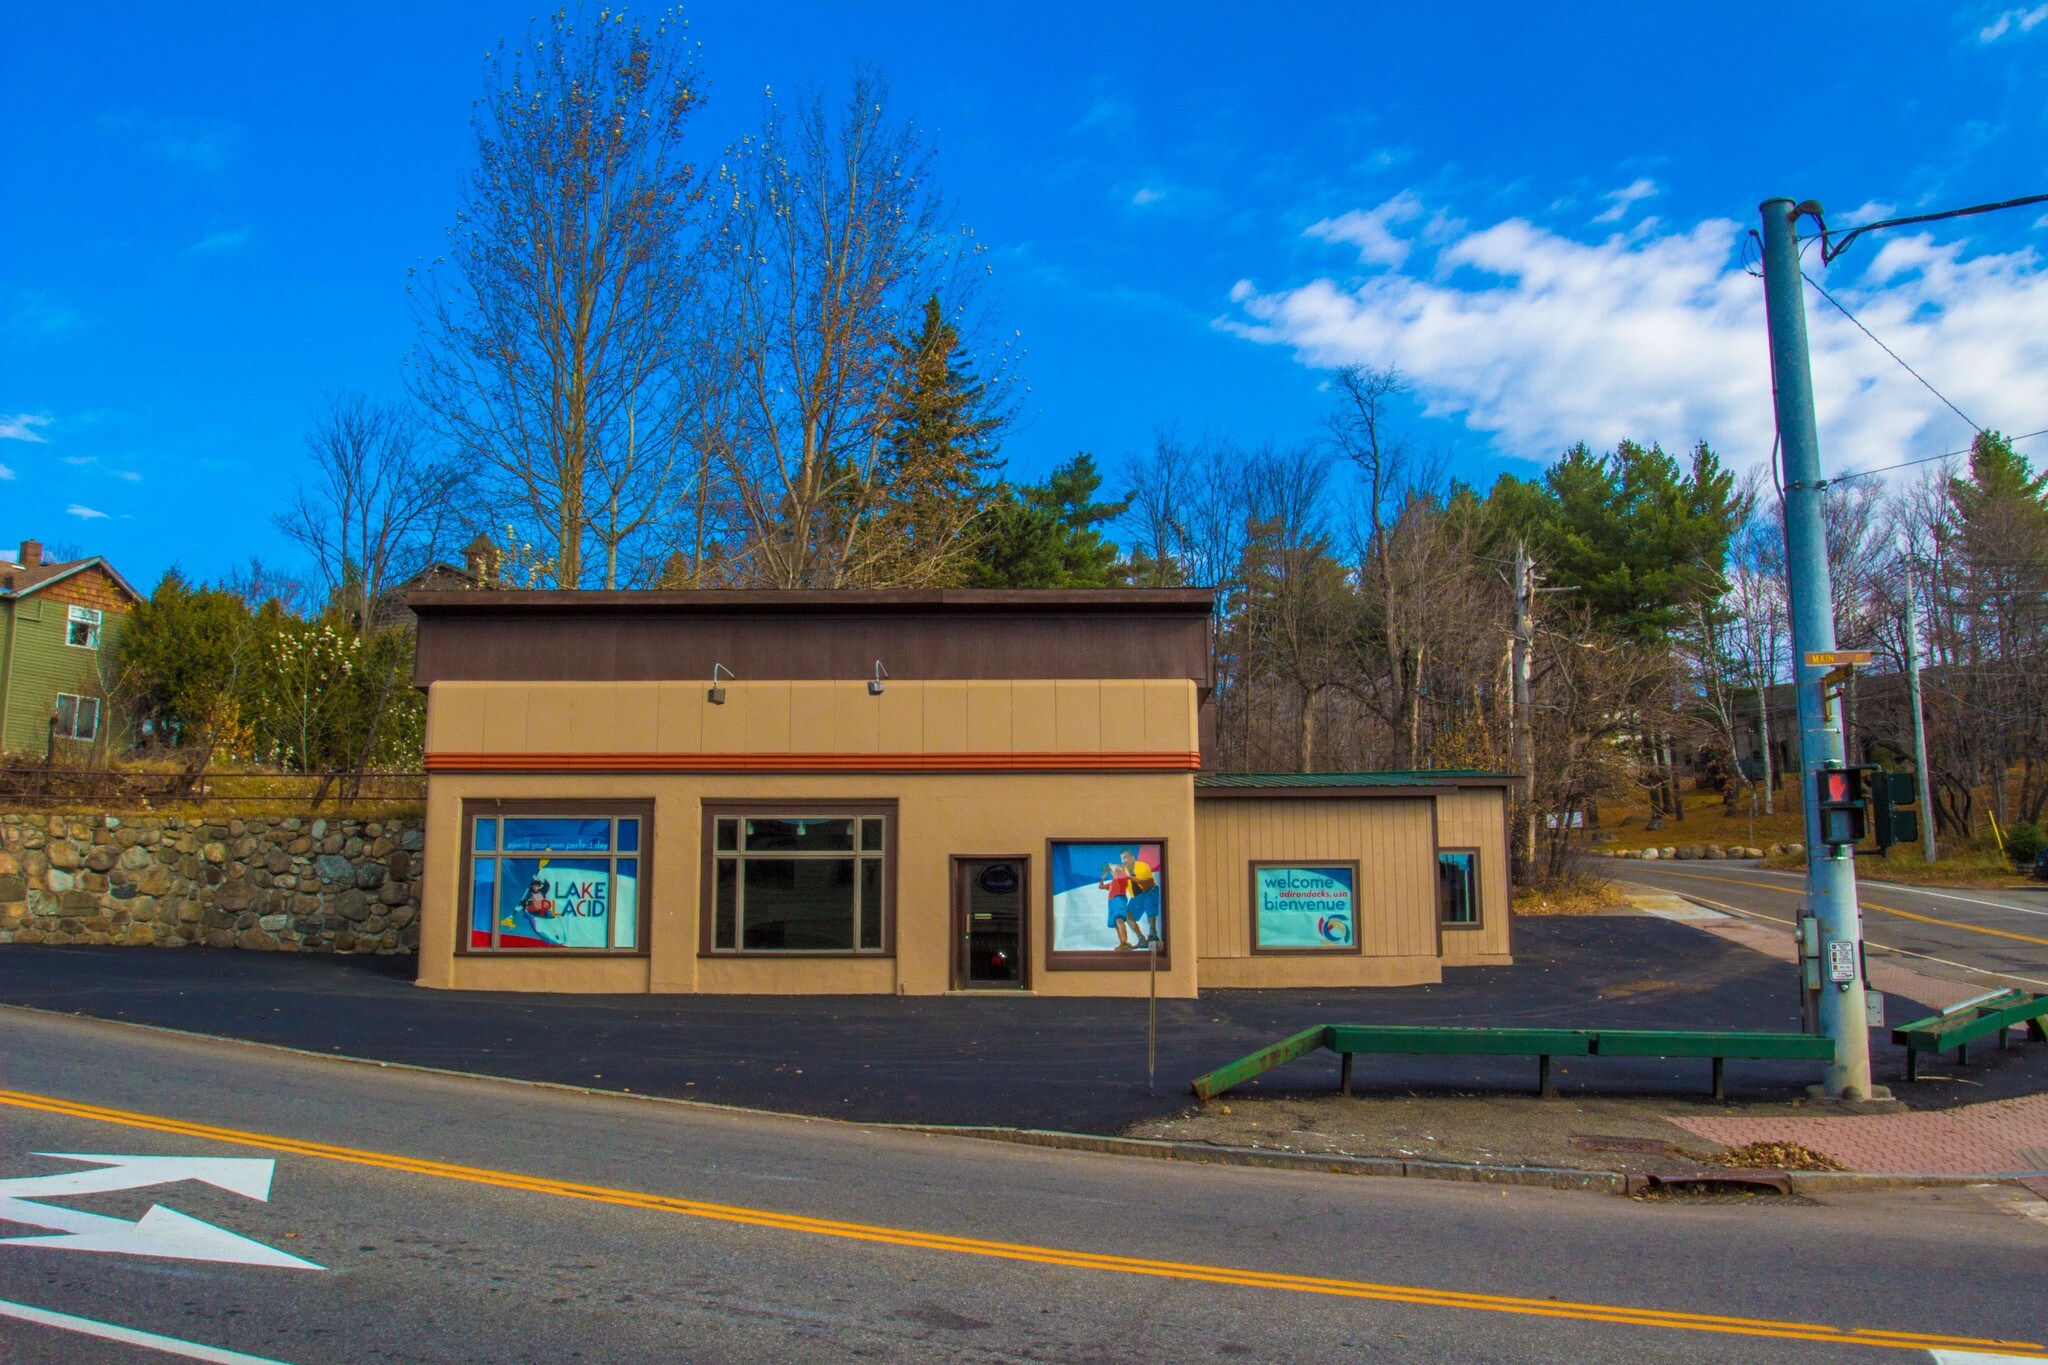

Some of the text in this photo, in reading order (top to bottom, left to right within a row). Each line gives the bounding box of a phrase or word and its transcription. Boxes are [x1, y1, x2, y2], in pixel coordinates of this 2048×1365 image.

[1812, 654, 1834, 664] MAIN
[507, 841, 530, 849] invent
[566, 839, 593, 851] perfect
[594, 840, 608, 851] day
[1265, 869, 1333, 889] welcome
[555, 882, 606, 899] LAKE
[540, 900, 604, 917] PLACID
[1264, 892, 1345, 910] bienvenue
